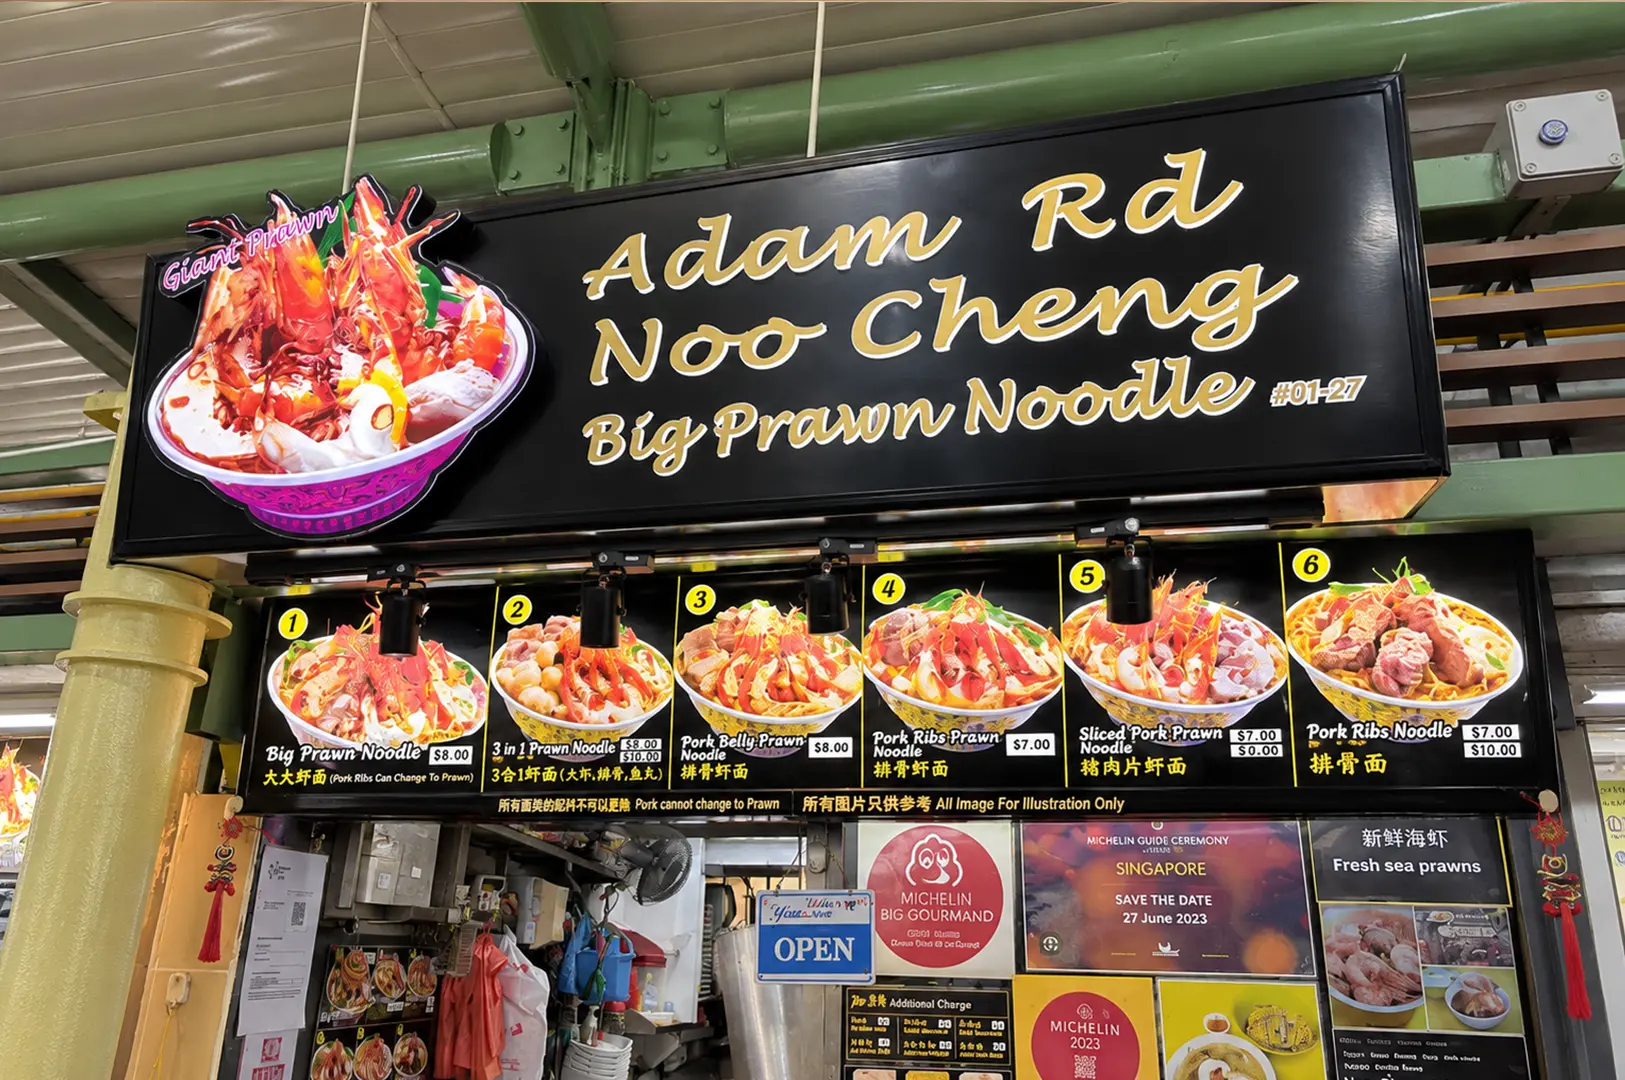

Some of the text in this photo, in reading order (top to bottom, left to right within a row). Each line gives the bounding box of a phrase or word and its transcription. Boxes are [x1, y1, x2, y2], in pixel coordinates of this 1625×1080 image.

[582, 147, 1244, 301] Adam Rd
[163, 205, 340, 291] Giant Prawn
[589, 262, 1300, 386] Noo Cheng
[581, 356, 1366, 478] Big Prawn Noodle #01-27
[1303, 555, 1319, 575] 6
[1079, 567, 1095, 585] 5
[882, 580, 896, 598] 4
[693, 590, 707, 609] 3
[511, 600, 525, 619] 2
[287, 612, 298, 634] 1
[872, 730, 1000, 744] Pork Ribs Prawn
[1079, 725, 1223, 741] Sliced Pork Prawn
[1237, 730, 1277, 741] $7.00
[1306, 721, 1452, 739] Pork Ribs Noodle
[1471, 726, 1512, 738] $7.00
[492, 739, 616, 756] 3 in 1 Prawn Noodle
[626, 740, 657, 750] $8.00
[680, 733, 805, 750] Pork Belly Prawn
[814, 742, 849, 754] $8.00
[1013, 739, 1050, 750] $7.00
[1080, 741, 1132, 754] Noodle
[266, 742, 421, 767] Big Prawn Noodle
[433, 748, 469, 761] $8.00
[623, 752, 659, 762] $10.00
[680, 749, 727, 761] Noodle
[873, 744, 923, 757] Noodle
[1471, 744, 1517, 756] $10.00
[329, 773, 352, 785] (Pork
[354, 773, 373, 783] Ribs
[375, 773, 392, 783] Can
[394, 772, 426, 784] Change
[429, 772, 440, 782] To
[441, 772, 474, 783] Prawn)
[635, 798, 658, 811] Pork
[660, 799, 693, 810] cannot
[695, 798, 732, 812] change
[734, 798, 745, 810] to
[747, 798, 780, 810] Prawn
[936, 797, 953, 810] All
[956, 797, 994, 813] Image
[998, 797, 1020, 810] For
[1022, 796, 1091, 811] Illustration
[1094, 797, 1125, 814] Only
[1087, 836, 1135, 845] MICHELIN
[1170, 836, 1229, 845] CEREMONY
[1116, 862, 1207, 876] SINGAPORE
[1333, 858, 1481, 876] Fresh sea prawns
[901, 892, 972, 906] MICHELIN
[1115, 895, 1213, 906] SAVE THE DATE
[907, 908, 994, 922] GOURMAND
[1123, 913, 1208, 924] 27 June 2023
[774, 937, 856, 962] OPEN
[1050, 1020, 1121, 1036] MICHELIN
[1070, 1037, 1101, 1050] 2023
